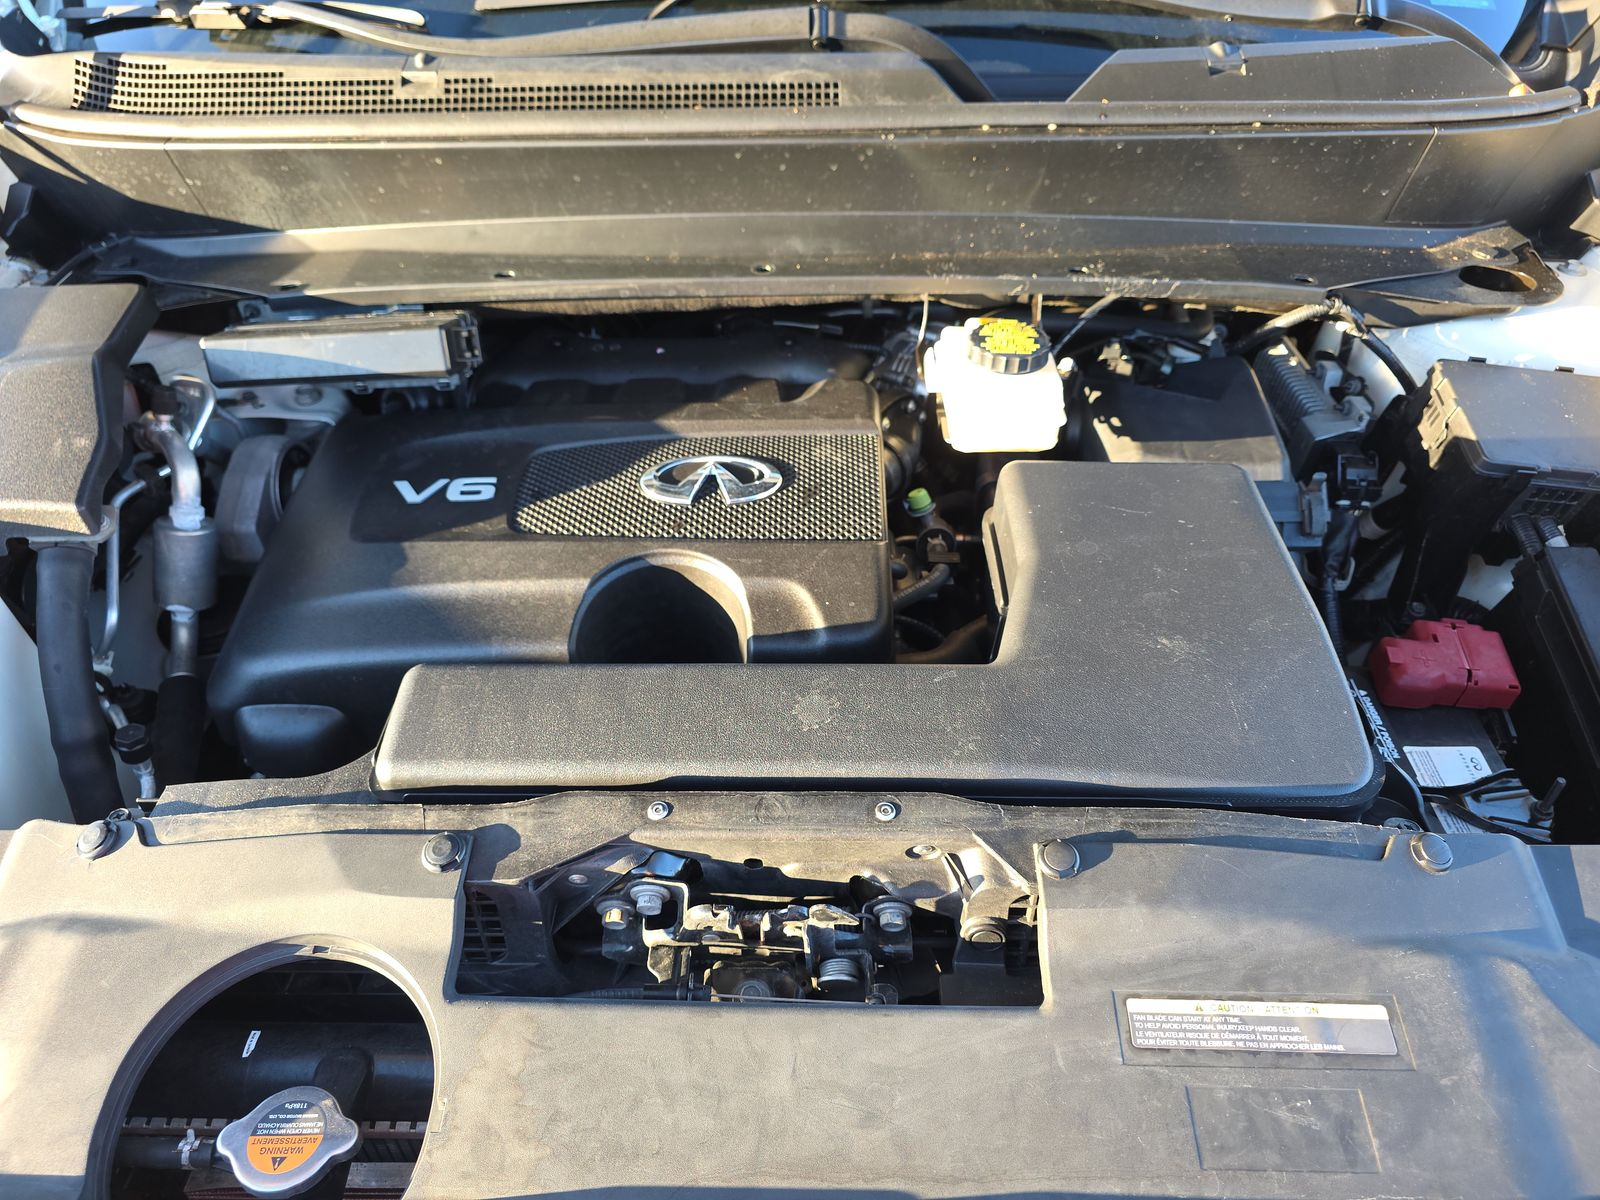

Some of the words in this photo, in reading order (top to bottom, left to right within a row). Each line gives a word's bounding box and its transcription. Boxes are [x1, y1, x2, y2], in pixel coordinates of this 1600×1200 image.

[393, 476, 498, 504] V6
[1361, 696, 1382, 726] DANGER
[1380, 732, 1400, 758] POISON
[1210, 1003, 1254, 1013] CAUTION
[1265, 1005, 1319, 1014] ATTENON
